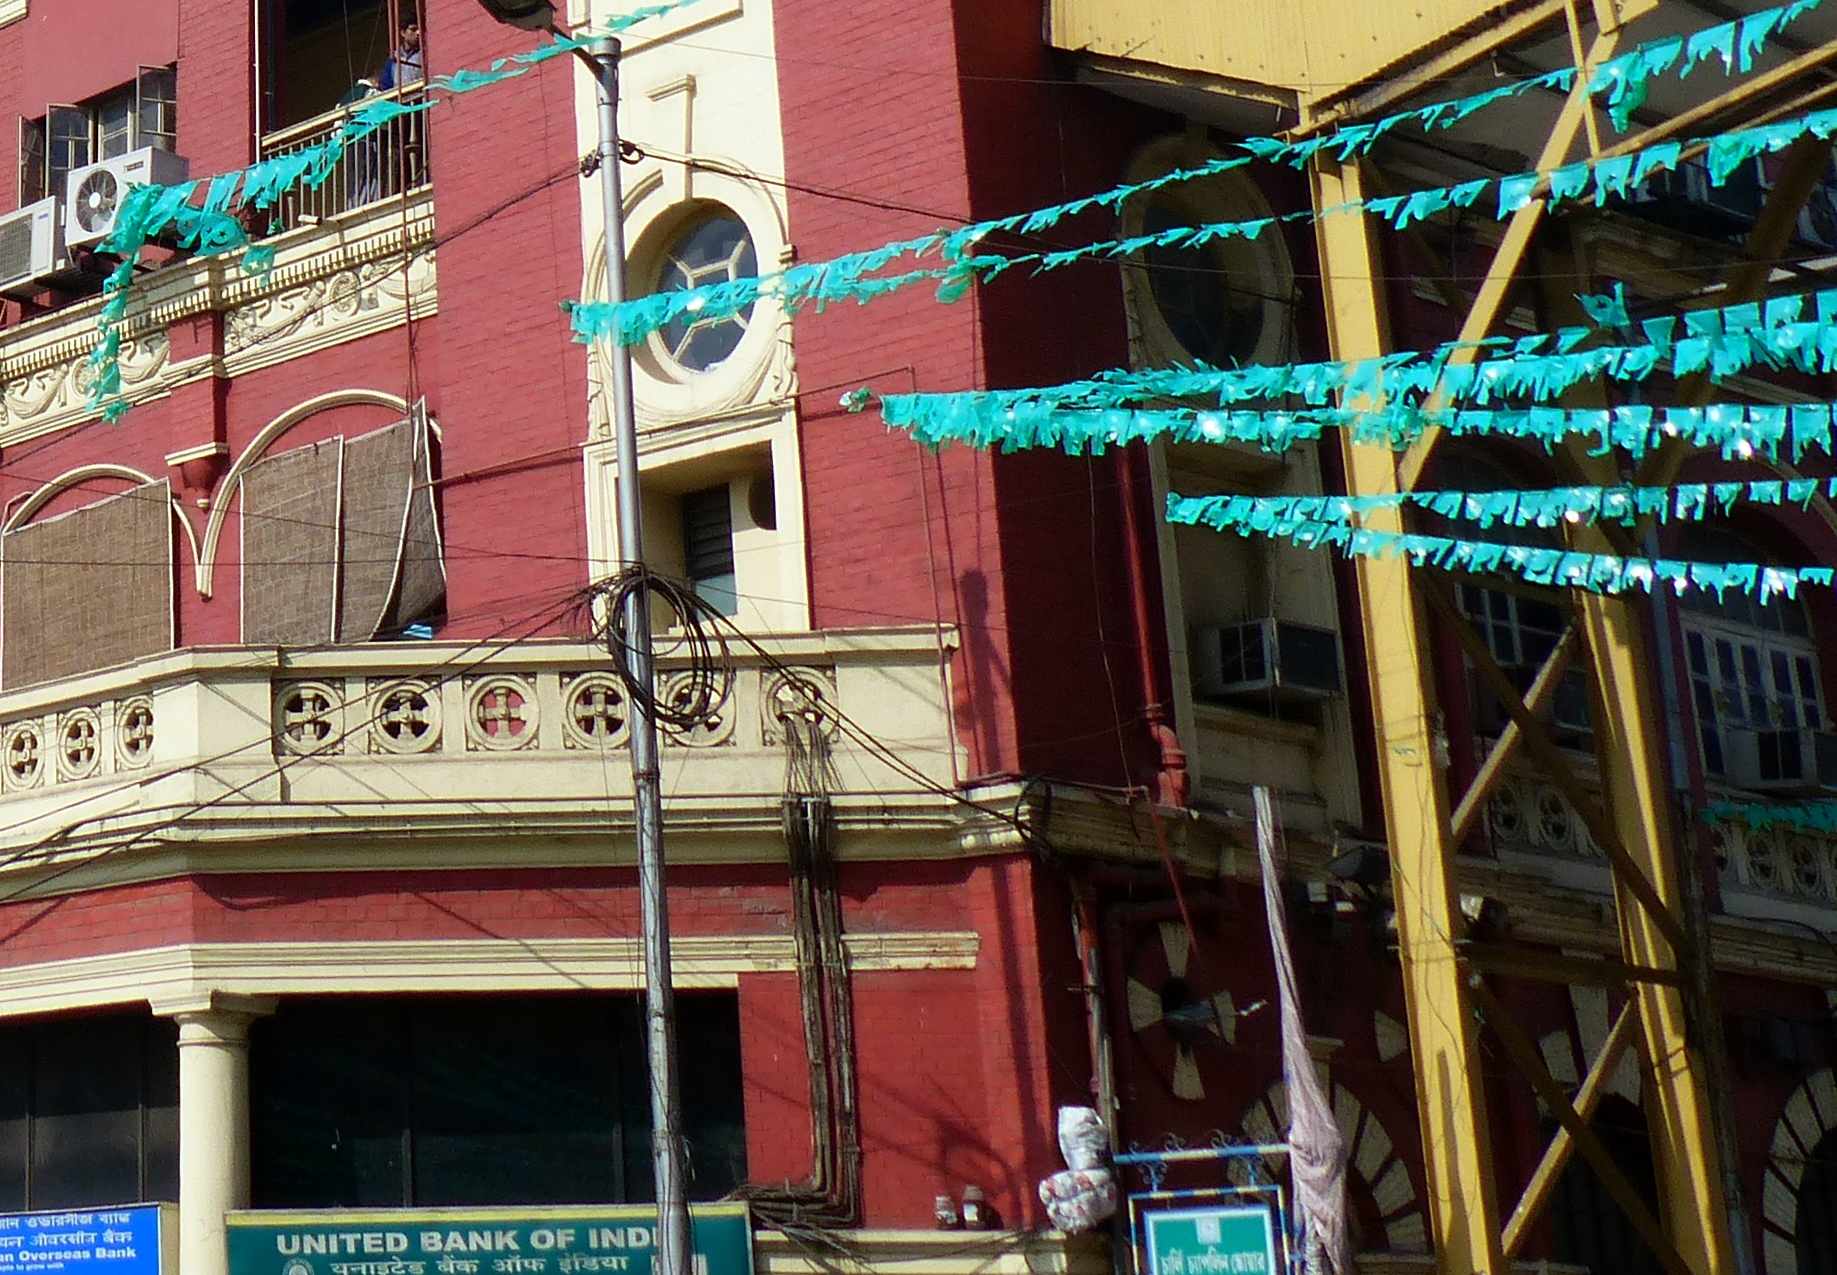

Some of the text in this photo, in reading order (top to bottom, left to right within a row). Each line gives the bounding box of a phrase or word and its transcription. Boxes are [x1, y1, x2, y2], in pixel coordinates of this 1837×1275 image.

[276, 1233, 408, 1255] UNITED
[421, 1230, 521, 1252] BANK
[529, 1228, 576, 1250] OF
[19, 1249, 91, 1262] Overseas
[95, 1246, 137, 1259] Bank
